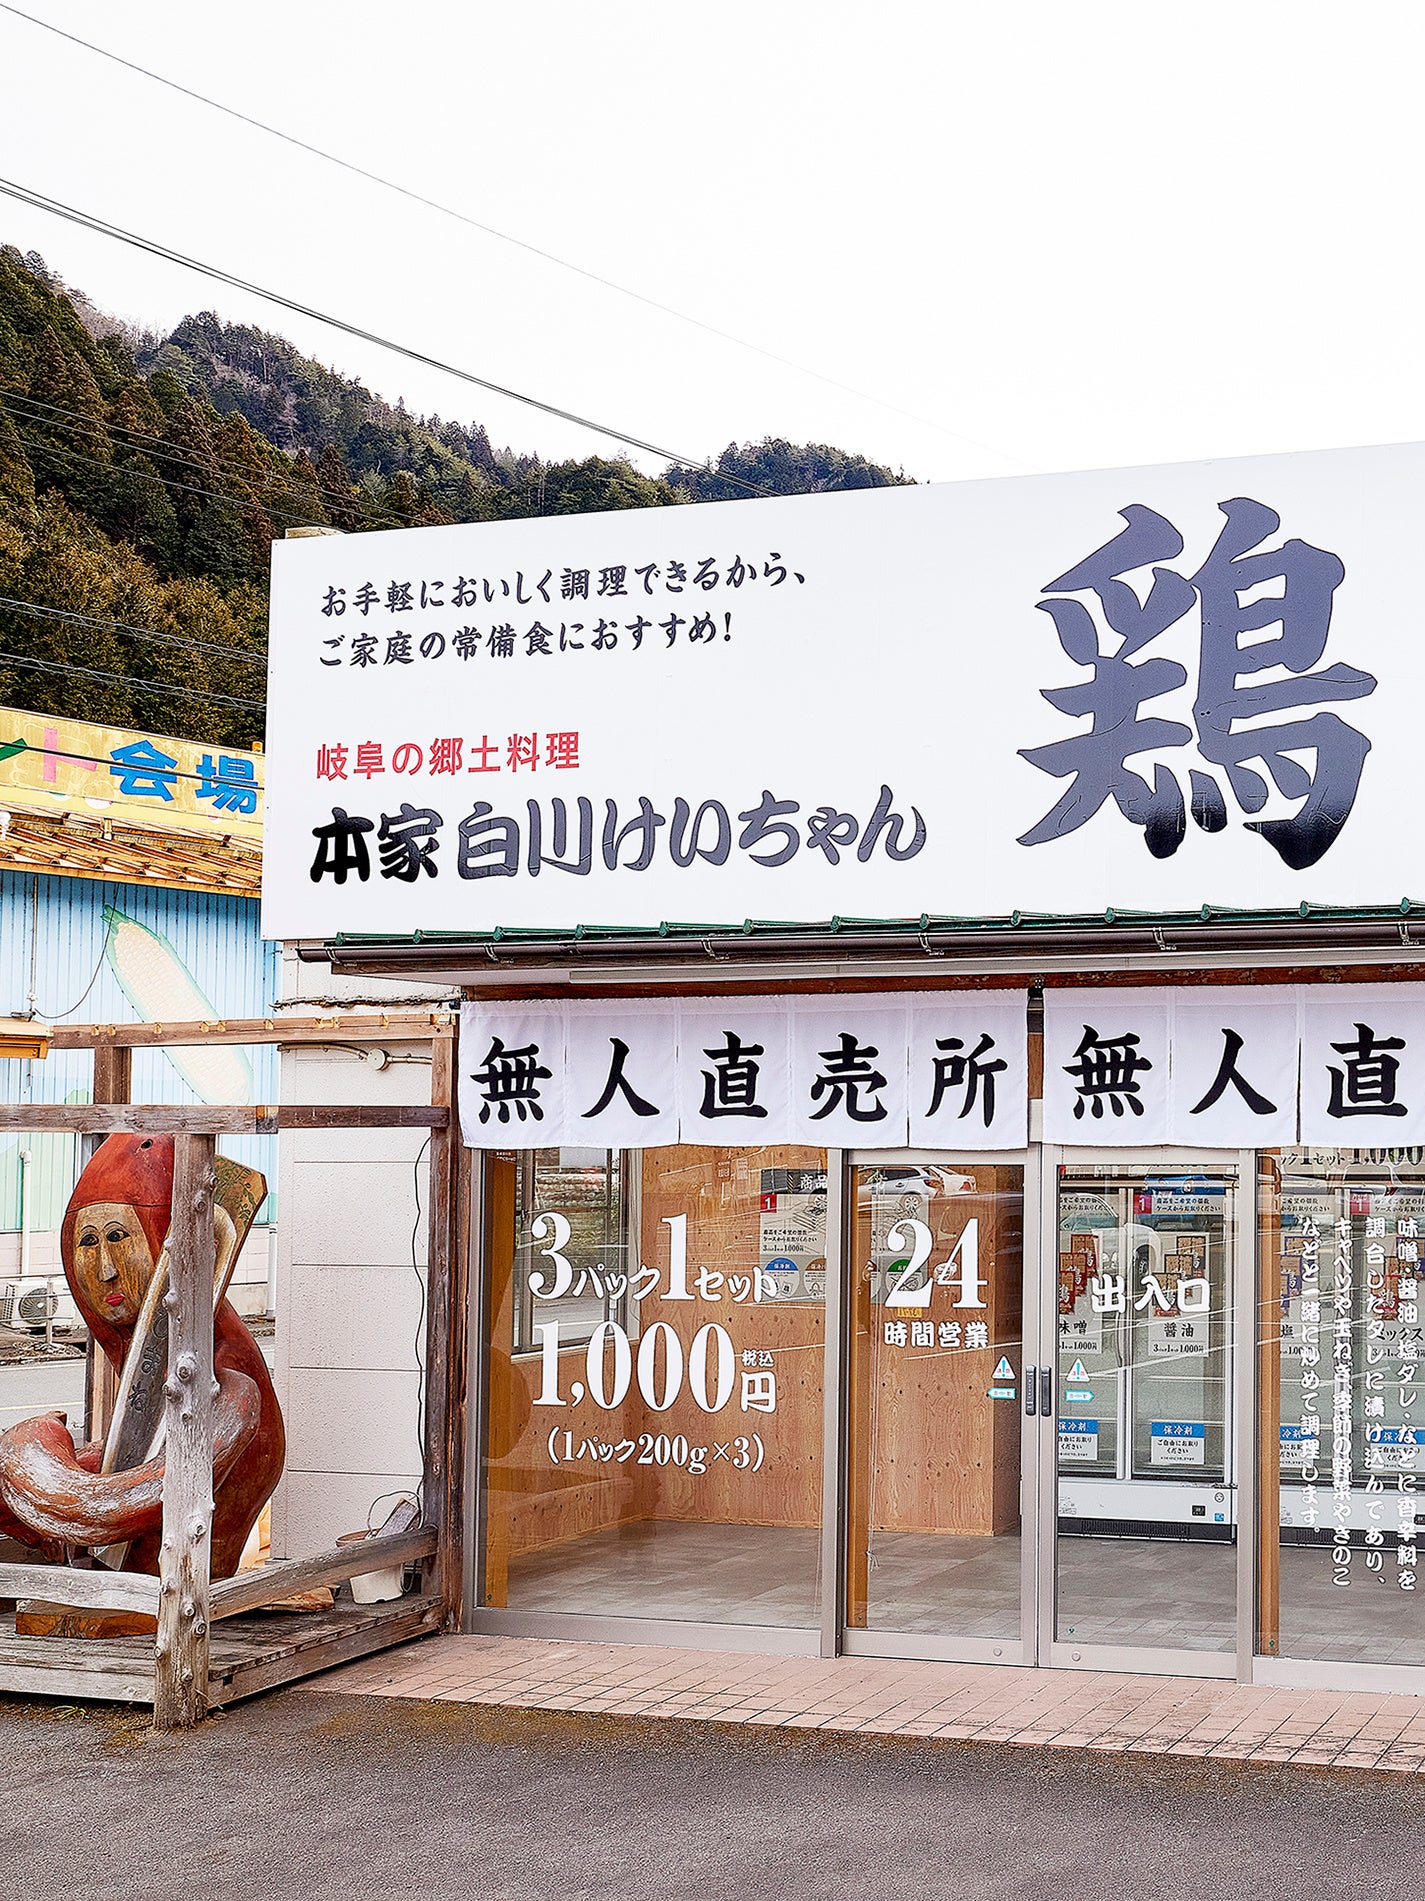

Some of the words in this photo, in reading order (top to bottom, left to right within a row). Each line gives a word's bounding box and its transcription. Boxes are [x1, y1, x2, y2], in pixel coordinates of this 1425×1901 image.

[320, 551, 809, 618] お手軽においしく調理できるから、
[318, 611, 734, 669] ご家庭の常備食におすすめ!
[1016, 498, 1377, 870] 鶏
[0, 728, 259, 814] ト会場
[316, 731, 581, 781] 岐阜の郷土料理
[469, 1030, 1008, 1128] 無人直売所
[765, 1197, 771, 1210] 1
[1139, 1197, 1146, 1212] 1
[528, 1212, 778, 1302] 3パック1セット
[884, 1216, 988, 1308] 24
[1091, 1274, 1211, 1314] 出入口
[742, 1348, 775, 1368] 税込
[883, 1320, 988, 1349] 時間営業
[1164, 1321, 1194, 1338] 醤油
[531, 1320, 777, 1414] 1,000円
